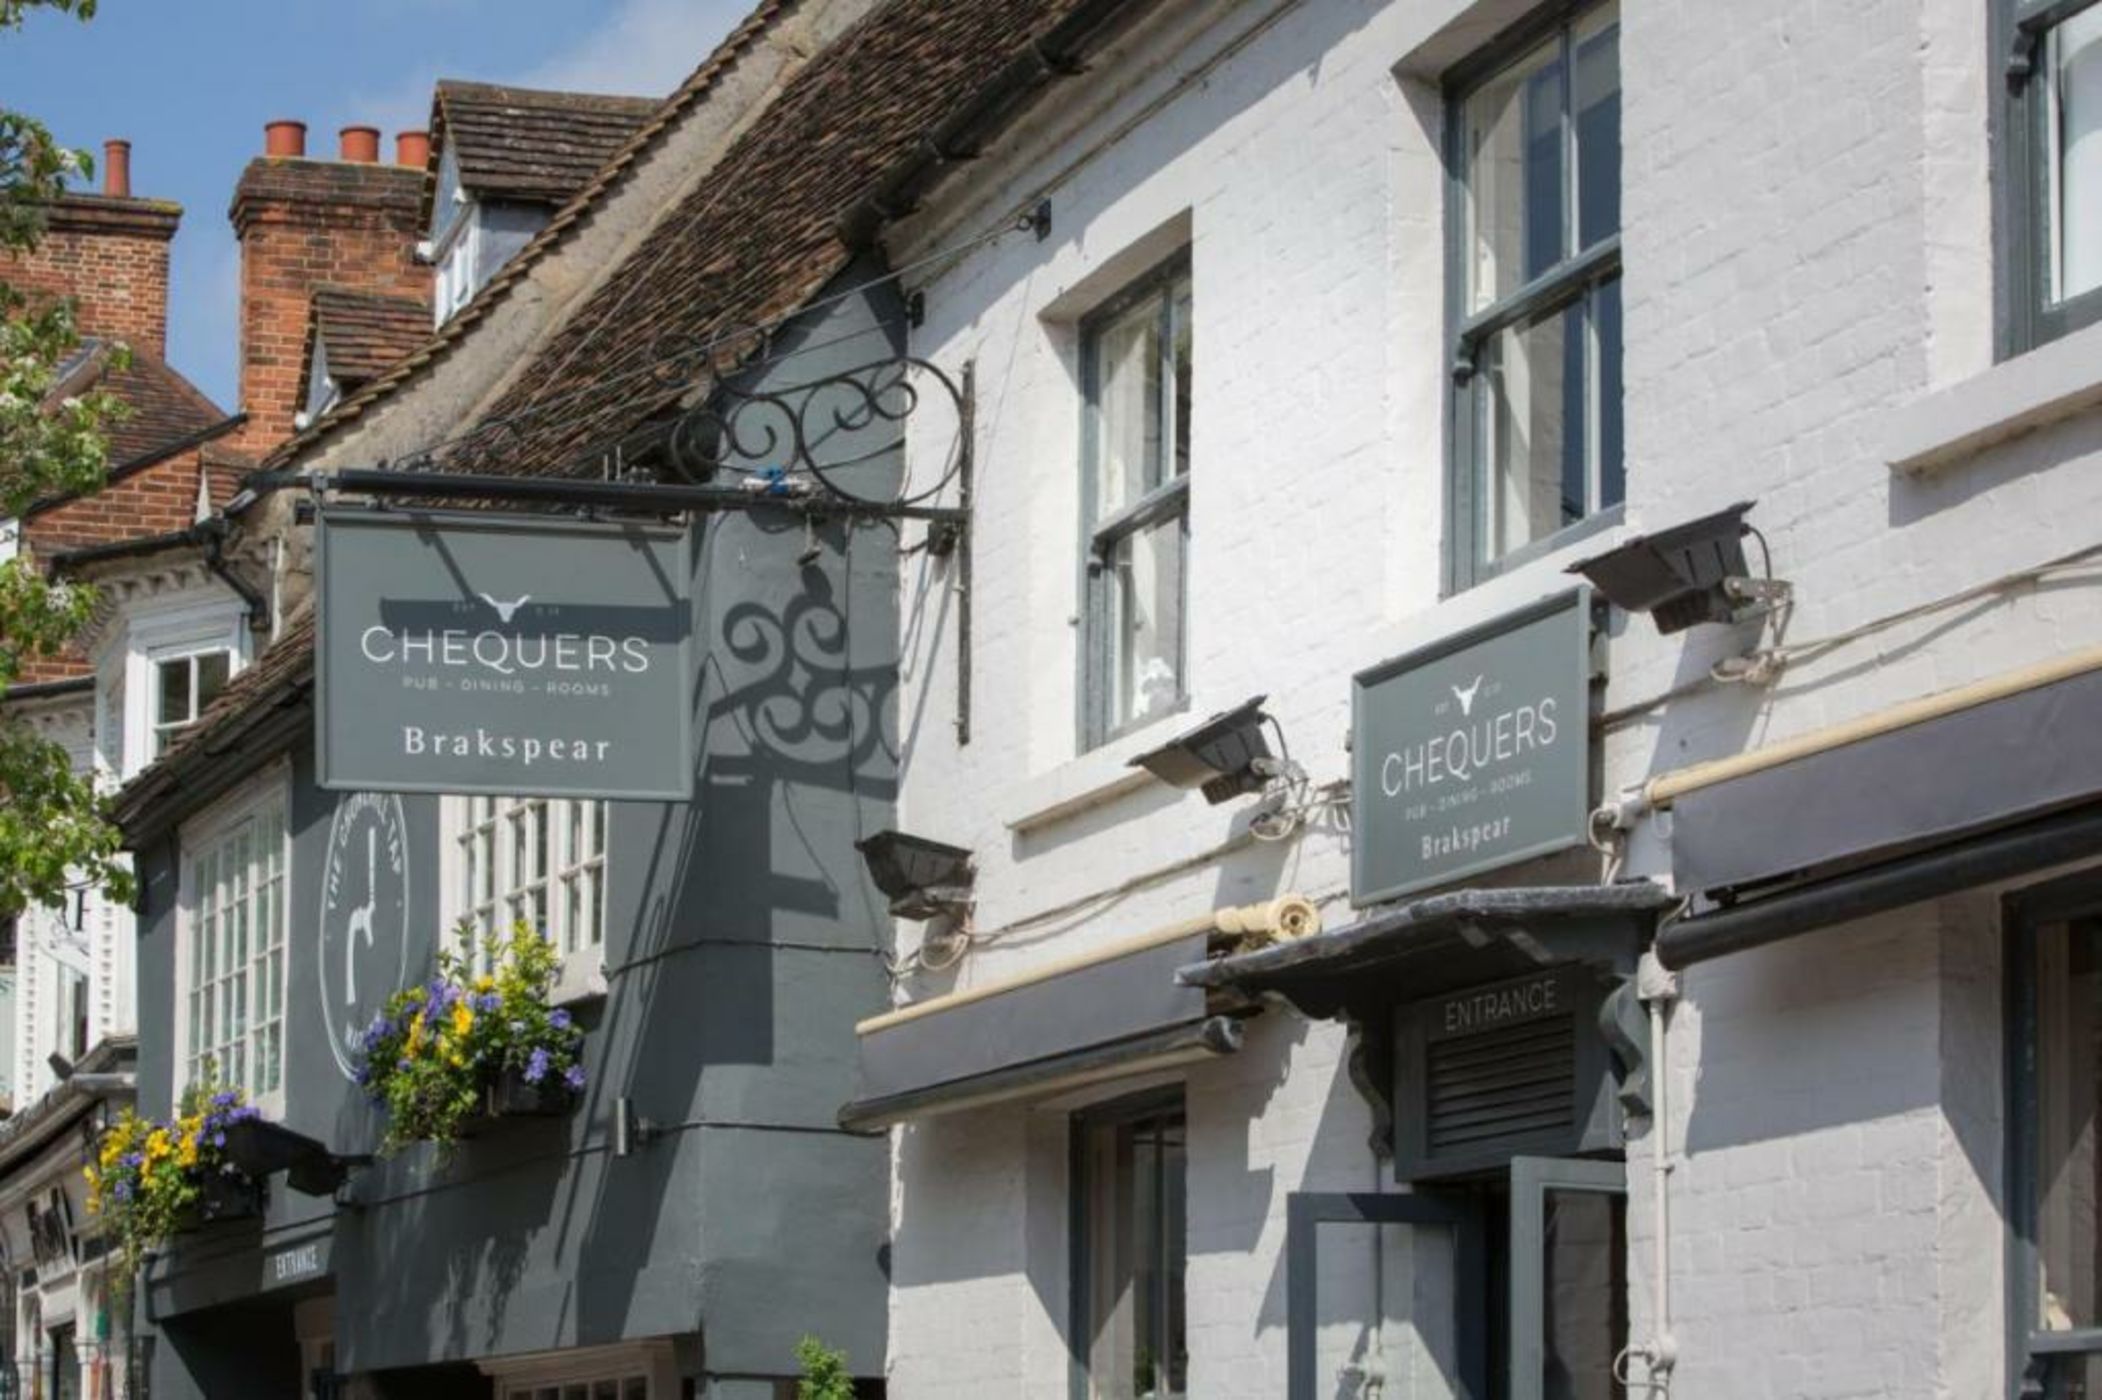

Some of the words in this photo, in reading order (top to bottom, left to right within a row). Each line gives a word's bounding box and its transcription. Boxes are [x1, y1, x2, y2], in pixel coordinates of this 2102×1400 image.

[360, 626, 650, 675] CHEQUERS
[402, 677, 439, 691] PUB
[460, 680, 525, 694] DINING
[546, 682, 611, 698] ROOMS
[404, 726, 612, 765] Brakspear
[1382, 697, 1558, 797] CHEQUERS
[1422, 816, 1512, 860] Brakspear
[1444, 980, 1557, 1032] ENTRANCE
